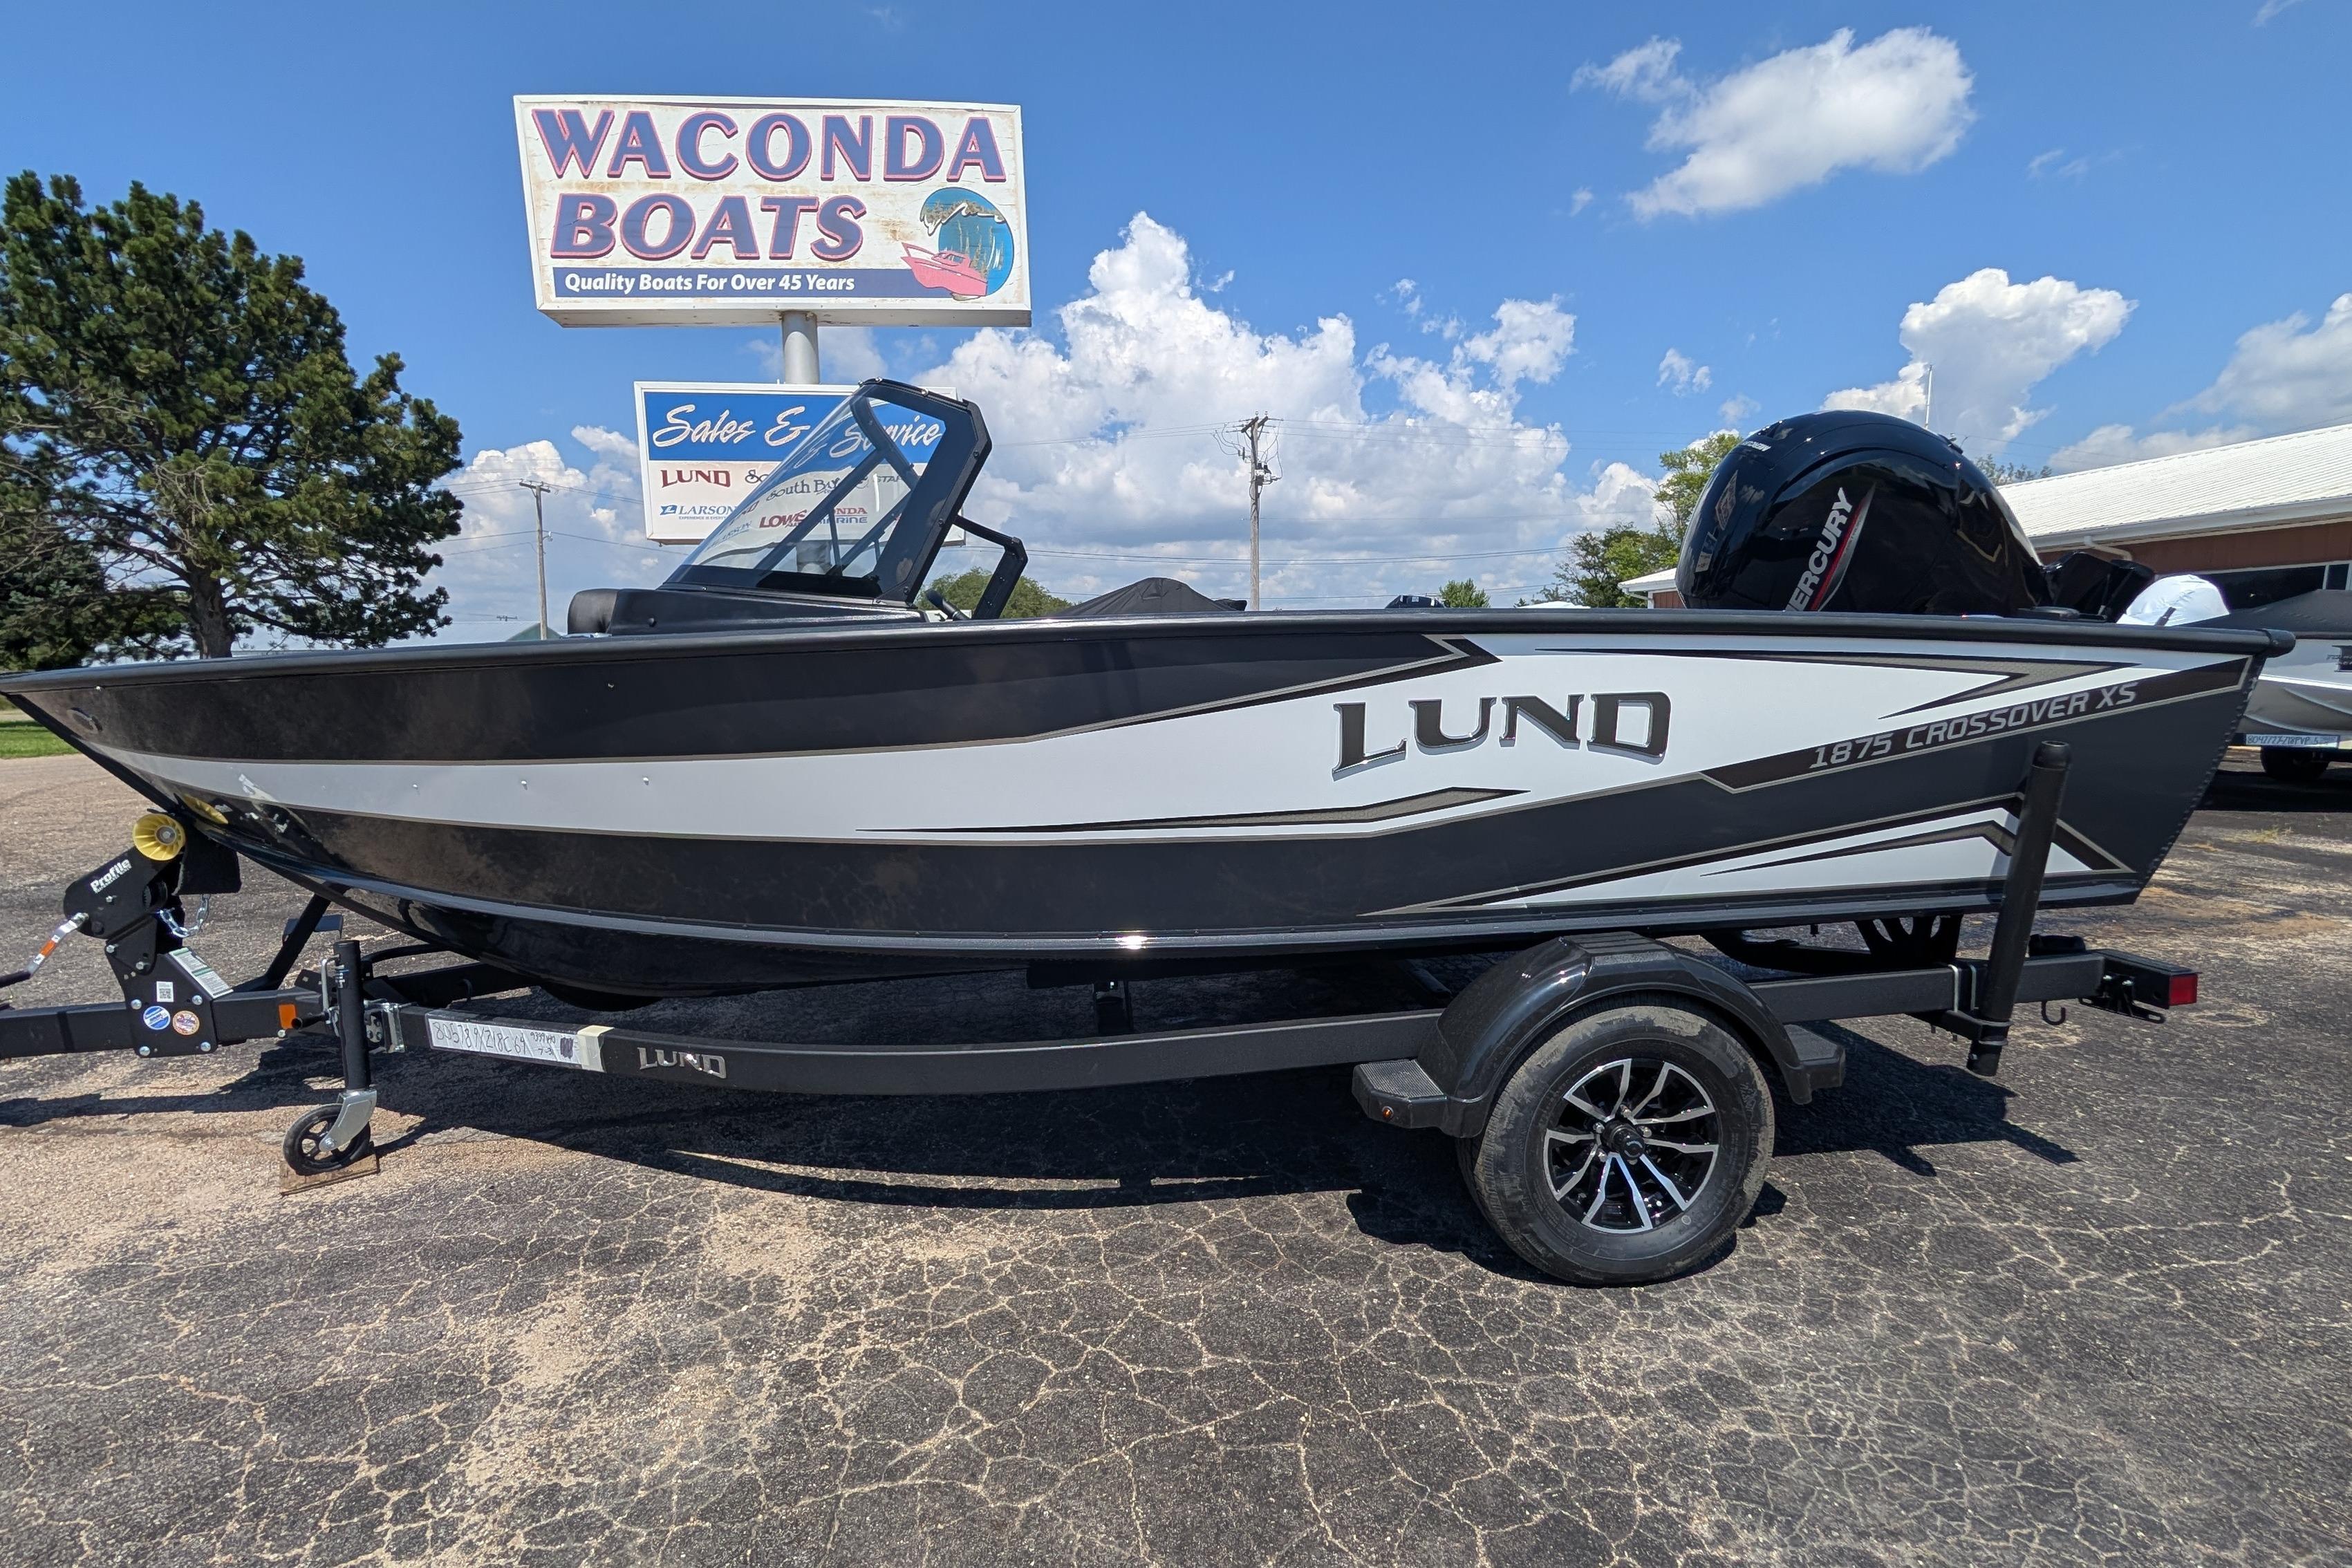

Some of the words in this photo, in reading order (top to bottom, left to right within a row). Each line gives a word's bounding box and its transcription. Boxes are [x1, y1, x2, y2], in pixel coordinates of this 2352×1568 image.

[532, 109, 1006, 183] WACONDA
[550, 192, 867, 261] BOATS
[566, 272, 635, 295] Quality
[639, 274, 692, 290] Boats
[696, 274, 727, 290] For
[731, 274, 775, 290] Over
[778, 274, 802, 290] 45
[805, 274, 855, 290] Years
[653, 404, 756, 447] Sales
[765, 406, 811, 448] &
[660, 469, 731, 488] LUND
[765, 479, 811, 501] South
[678, 505, 736, 515] LARSON
[1785, 487, 1853, 612] ERCURY
[1332, 691, 1671, 782] LUND
[1809, 733, 1893, 769] 1875
[1905, 693, 2090, 750] CROSSOVER
[2096, 682, 2139, 710] XS
[90, 859, 131, 892] Profile
[637, 1047, 727, 1079] LUND
